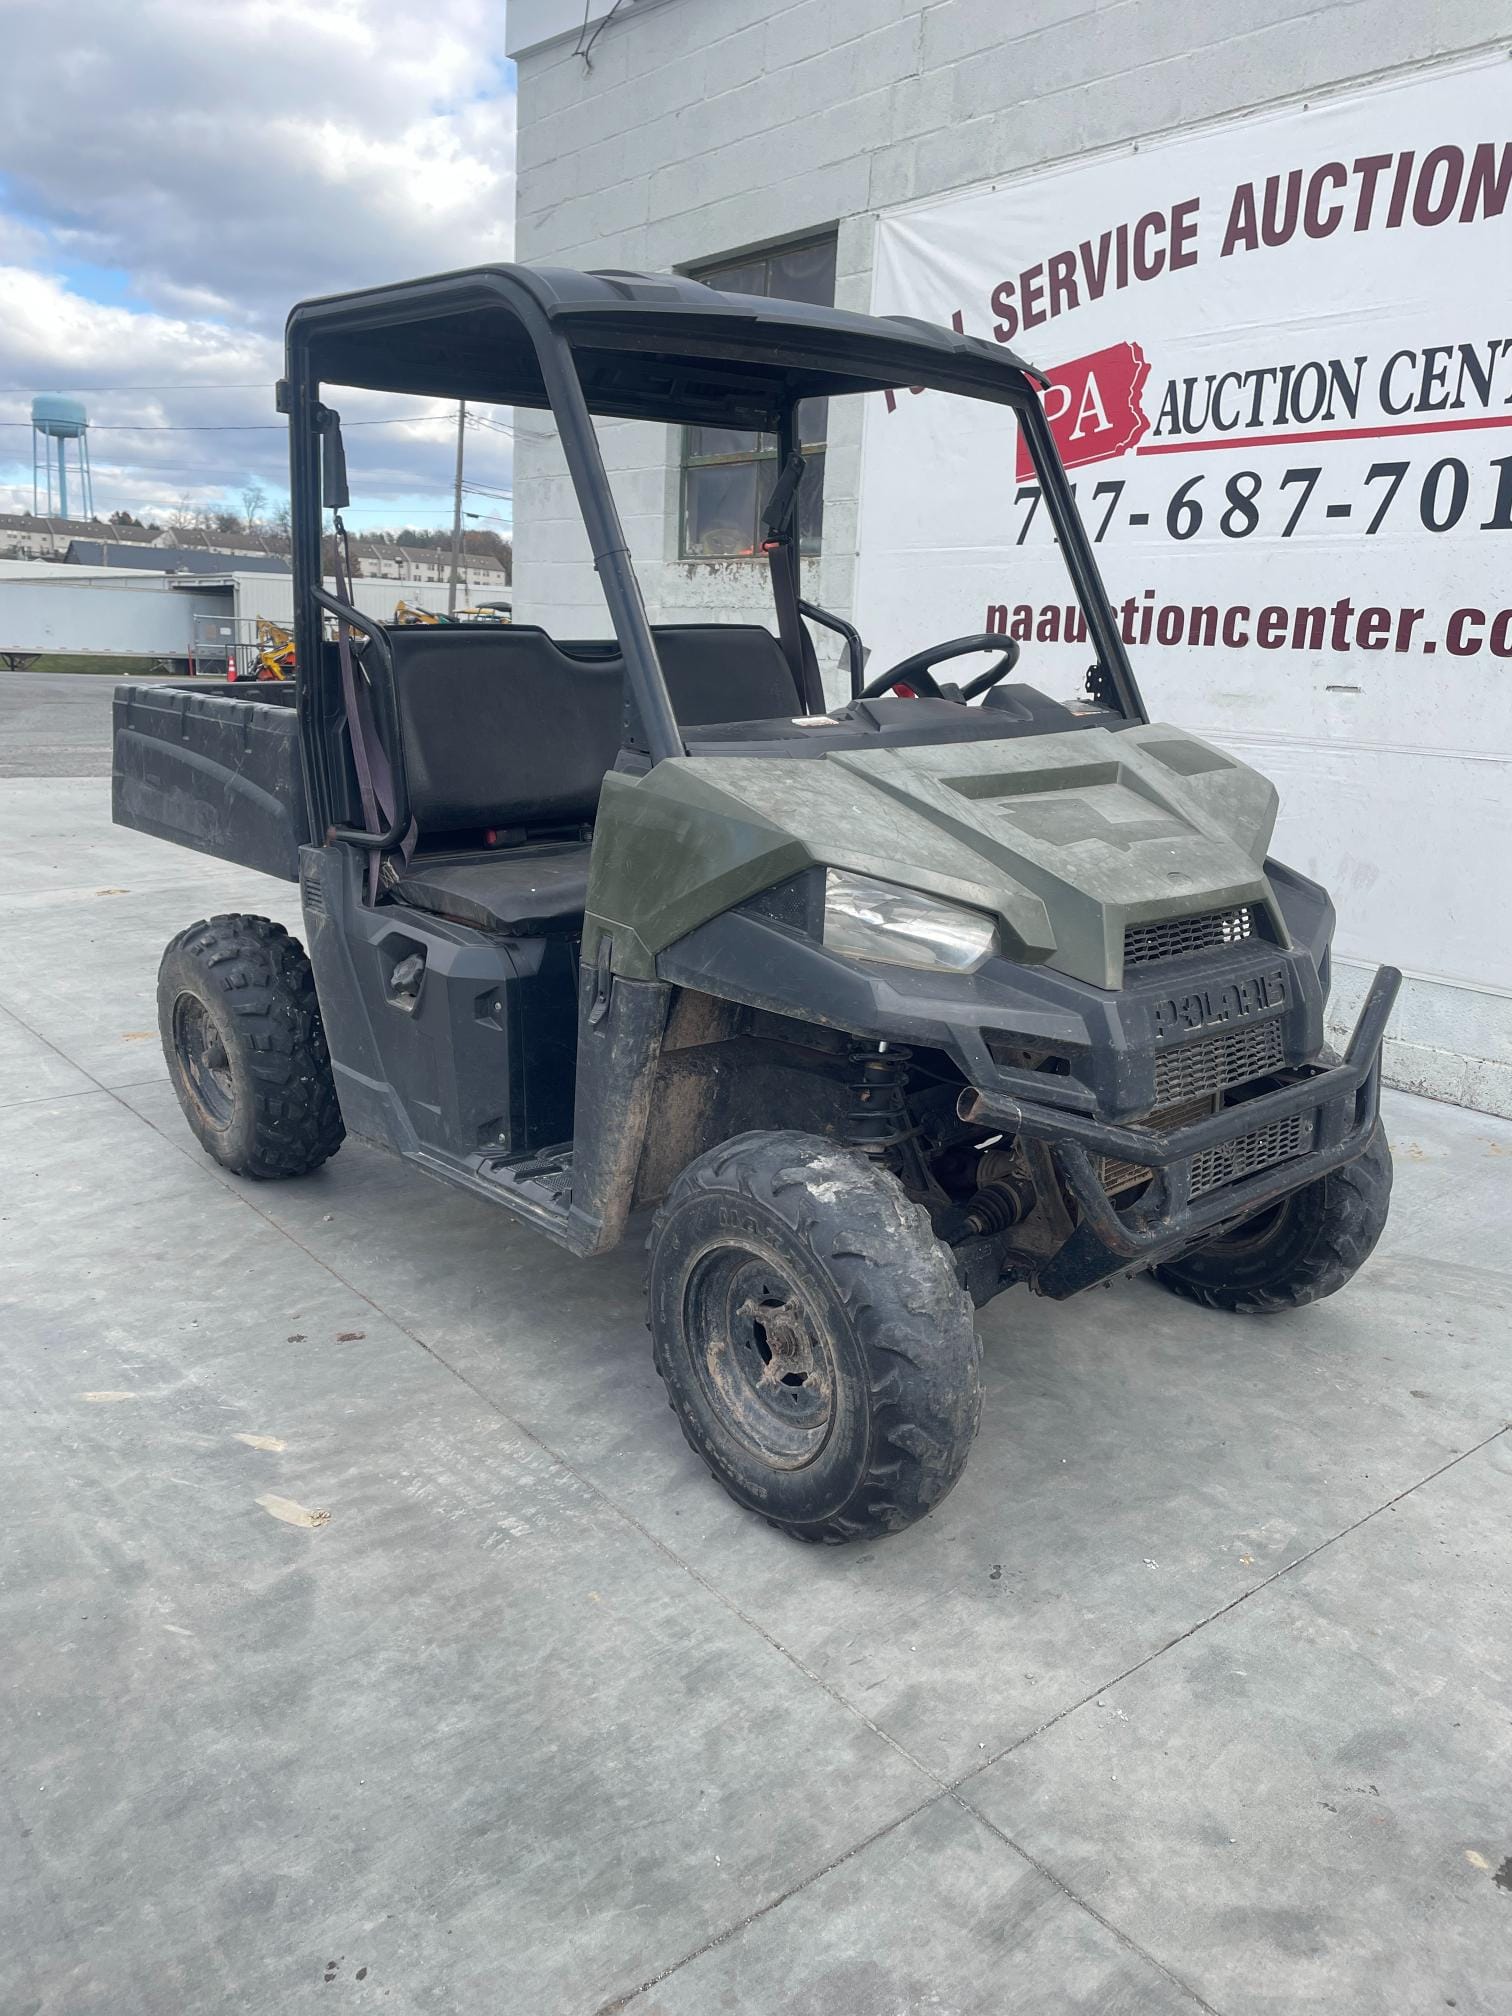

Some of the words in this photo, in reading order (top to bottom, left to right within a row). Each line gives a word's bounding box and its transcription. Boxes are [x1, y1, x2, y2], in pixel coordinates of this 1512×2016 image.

[991, 197, 1201, 344] SERVICE
[1036, 371, 1114, 441] PA
[1153, 356, 1367, 437] AUCTION
[1013, 454, 1512, 546] 77-687-701
[1153, 970, 1286, 1039] POLARIS
